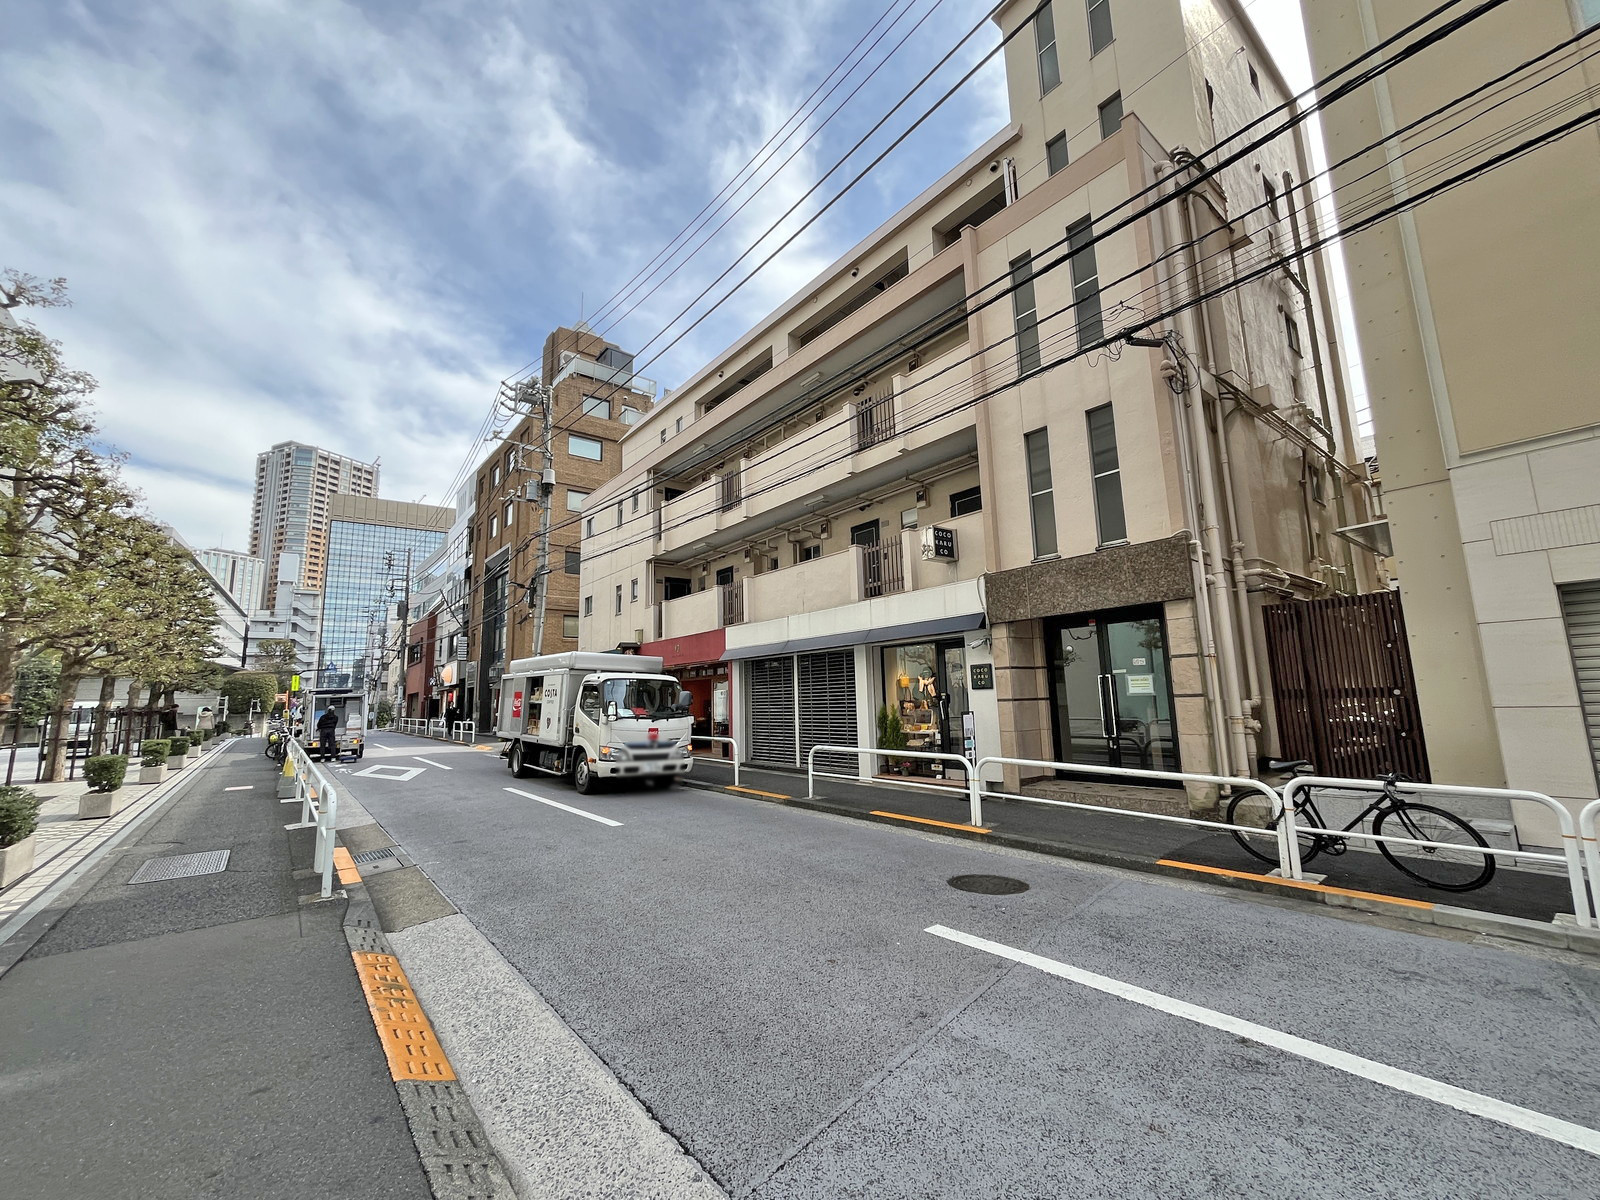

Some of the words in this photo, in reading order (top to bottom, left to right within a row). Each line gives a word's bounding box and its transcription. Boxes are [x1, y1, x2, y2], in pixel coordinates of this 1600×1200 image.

[934, 530, 952, 539] COCO
[935, 539, 952, 547] KARU
[544, 688, 558, 699] COSTA
